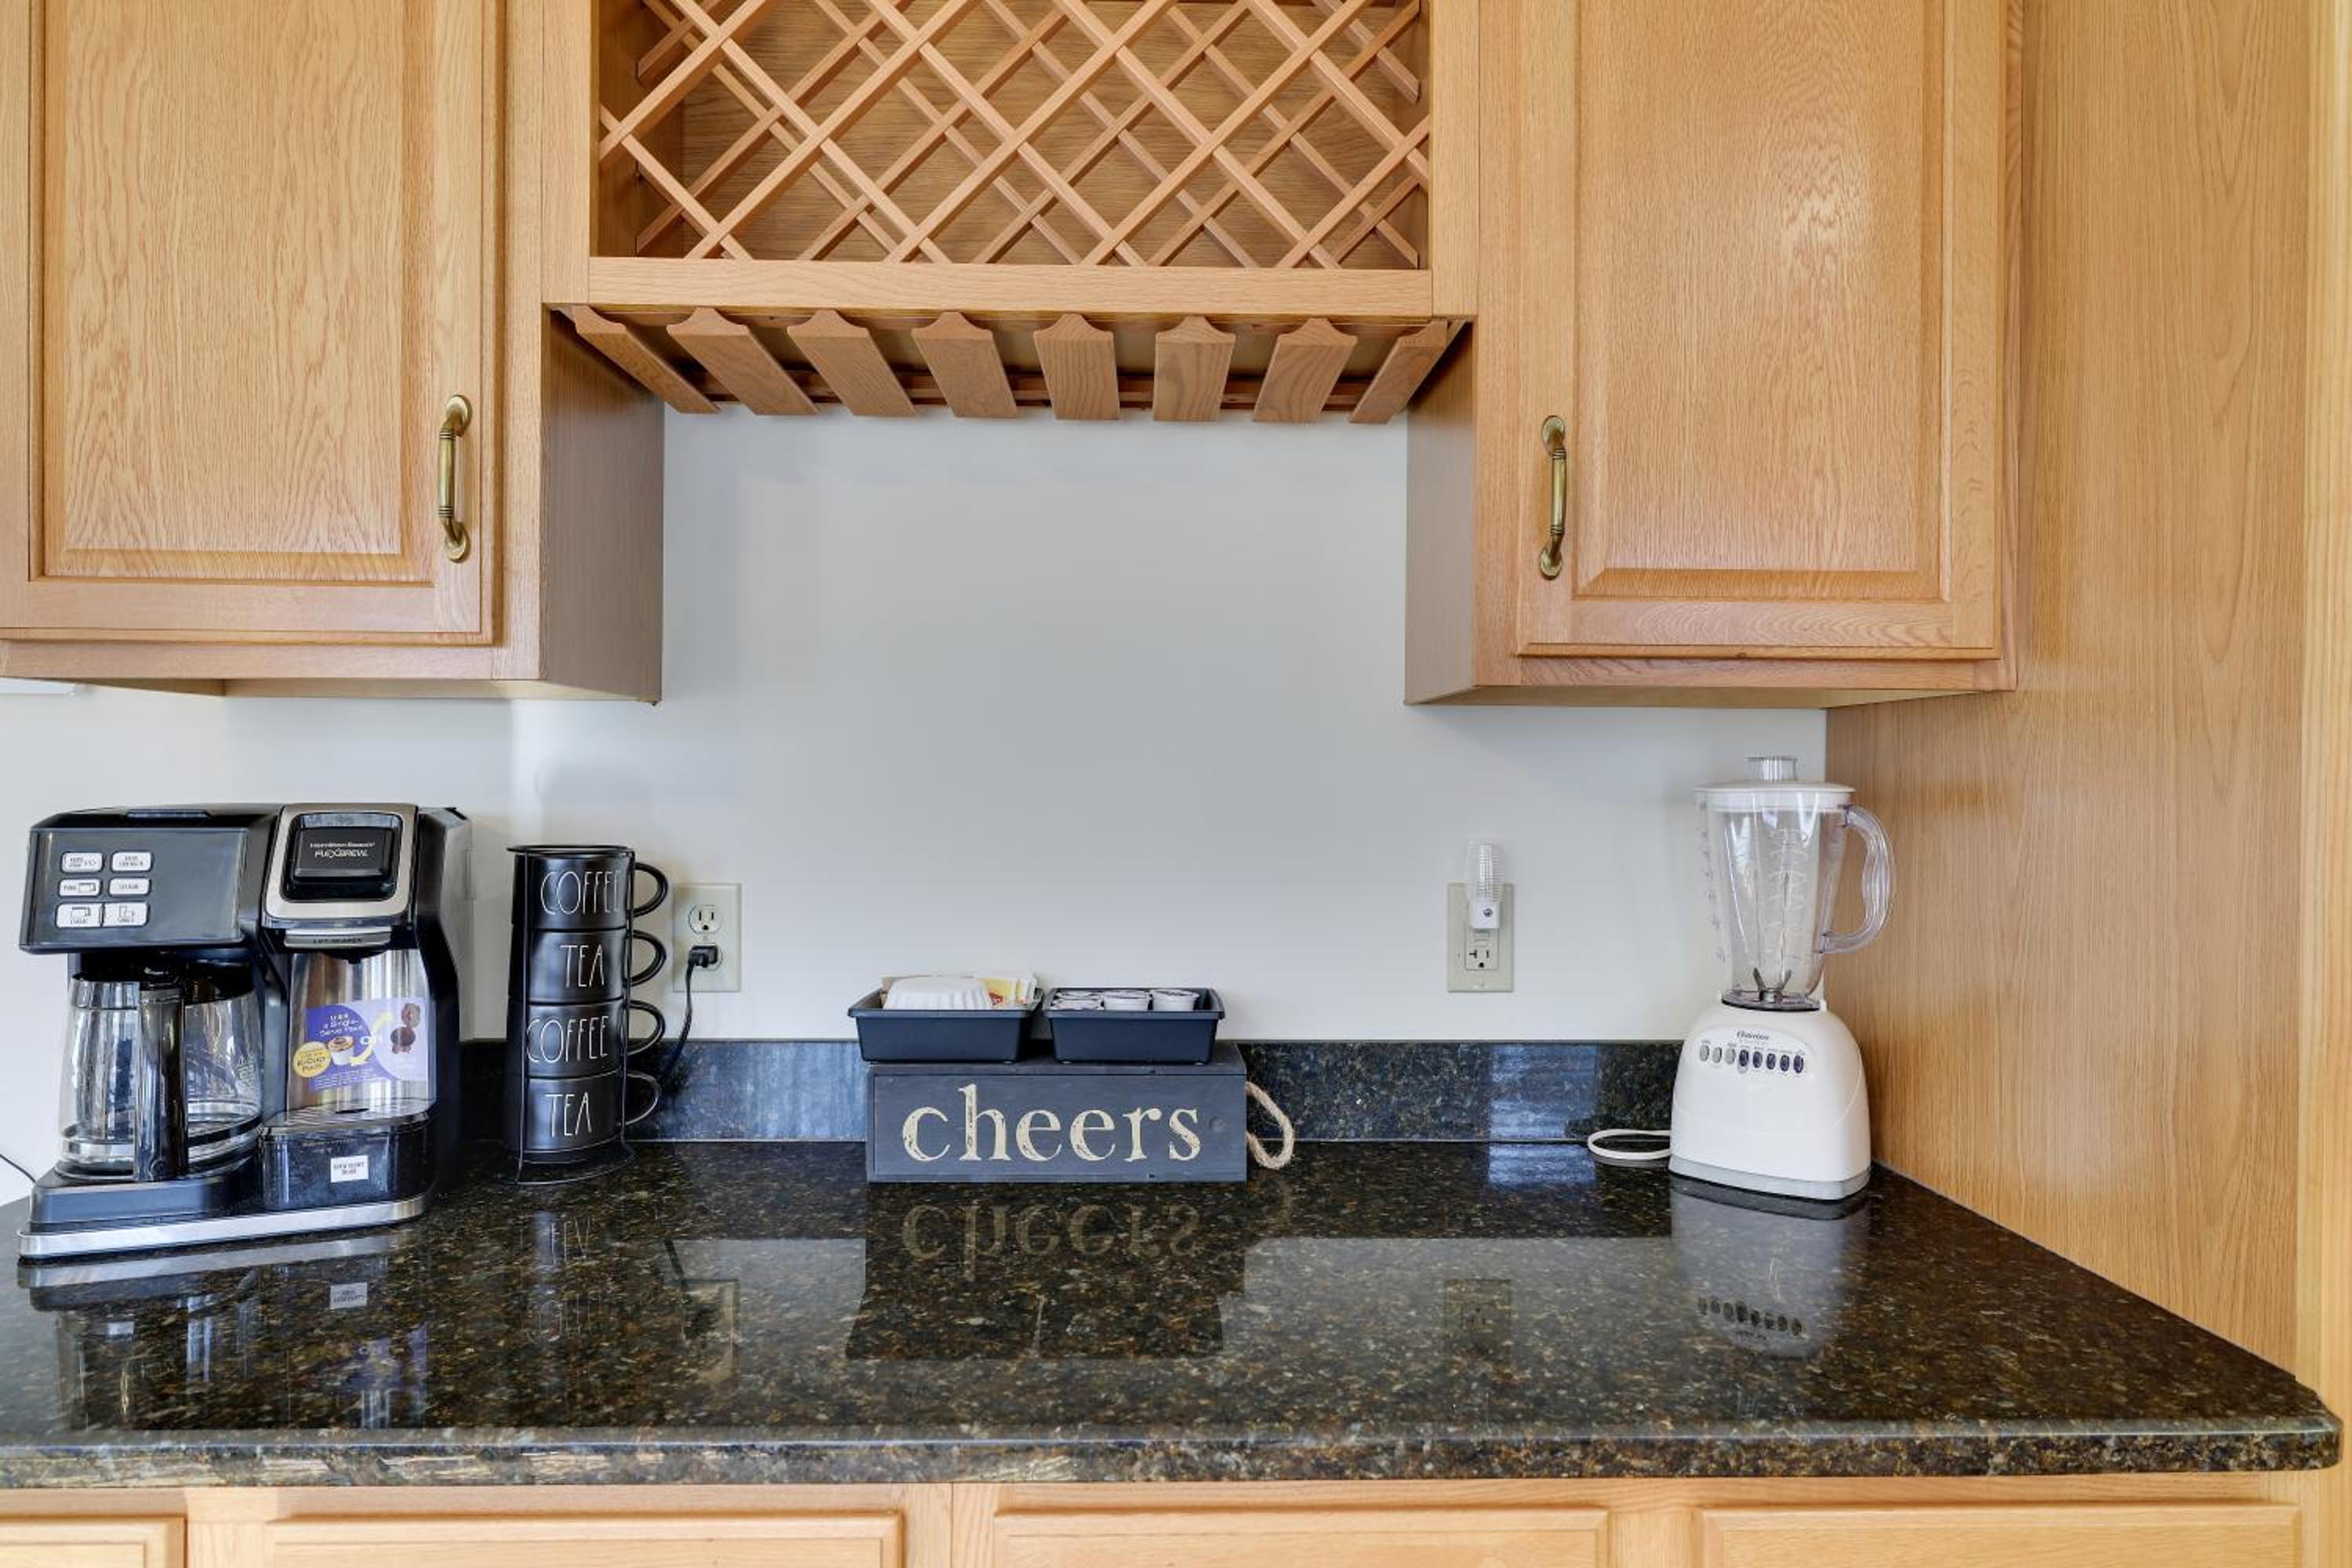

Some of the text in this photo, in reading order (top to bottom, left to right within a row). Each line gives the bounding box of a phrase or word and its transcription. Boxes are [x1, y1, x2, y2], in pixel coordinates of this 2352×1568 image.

[559, 943, 604, 989] TEA
[526, 1015, 609, 1064] COFFEE
[545, 1091, 592, 1138] TEA
[902, 1083, 1201, 1162] cheers
